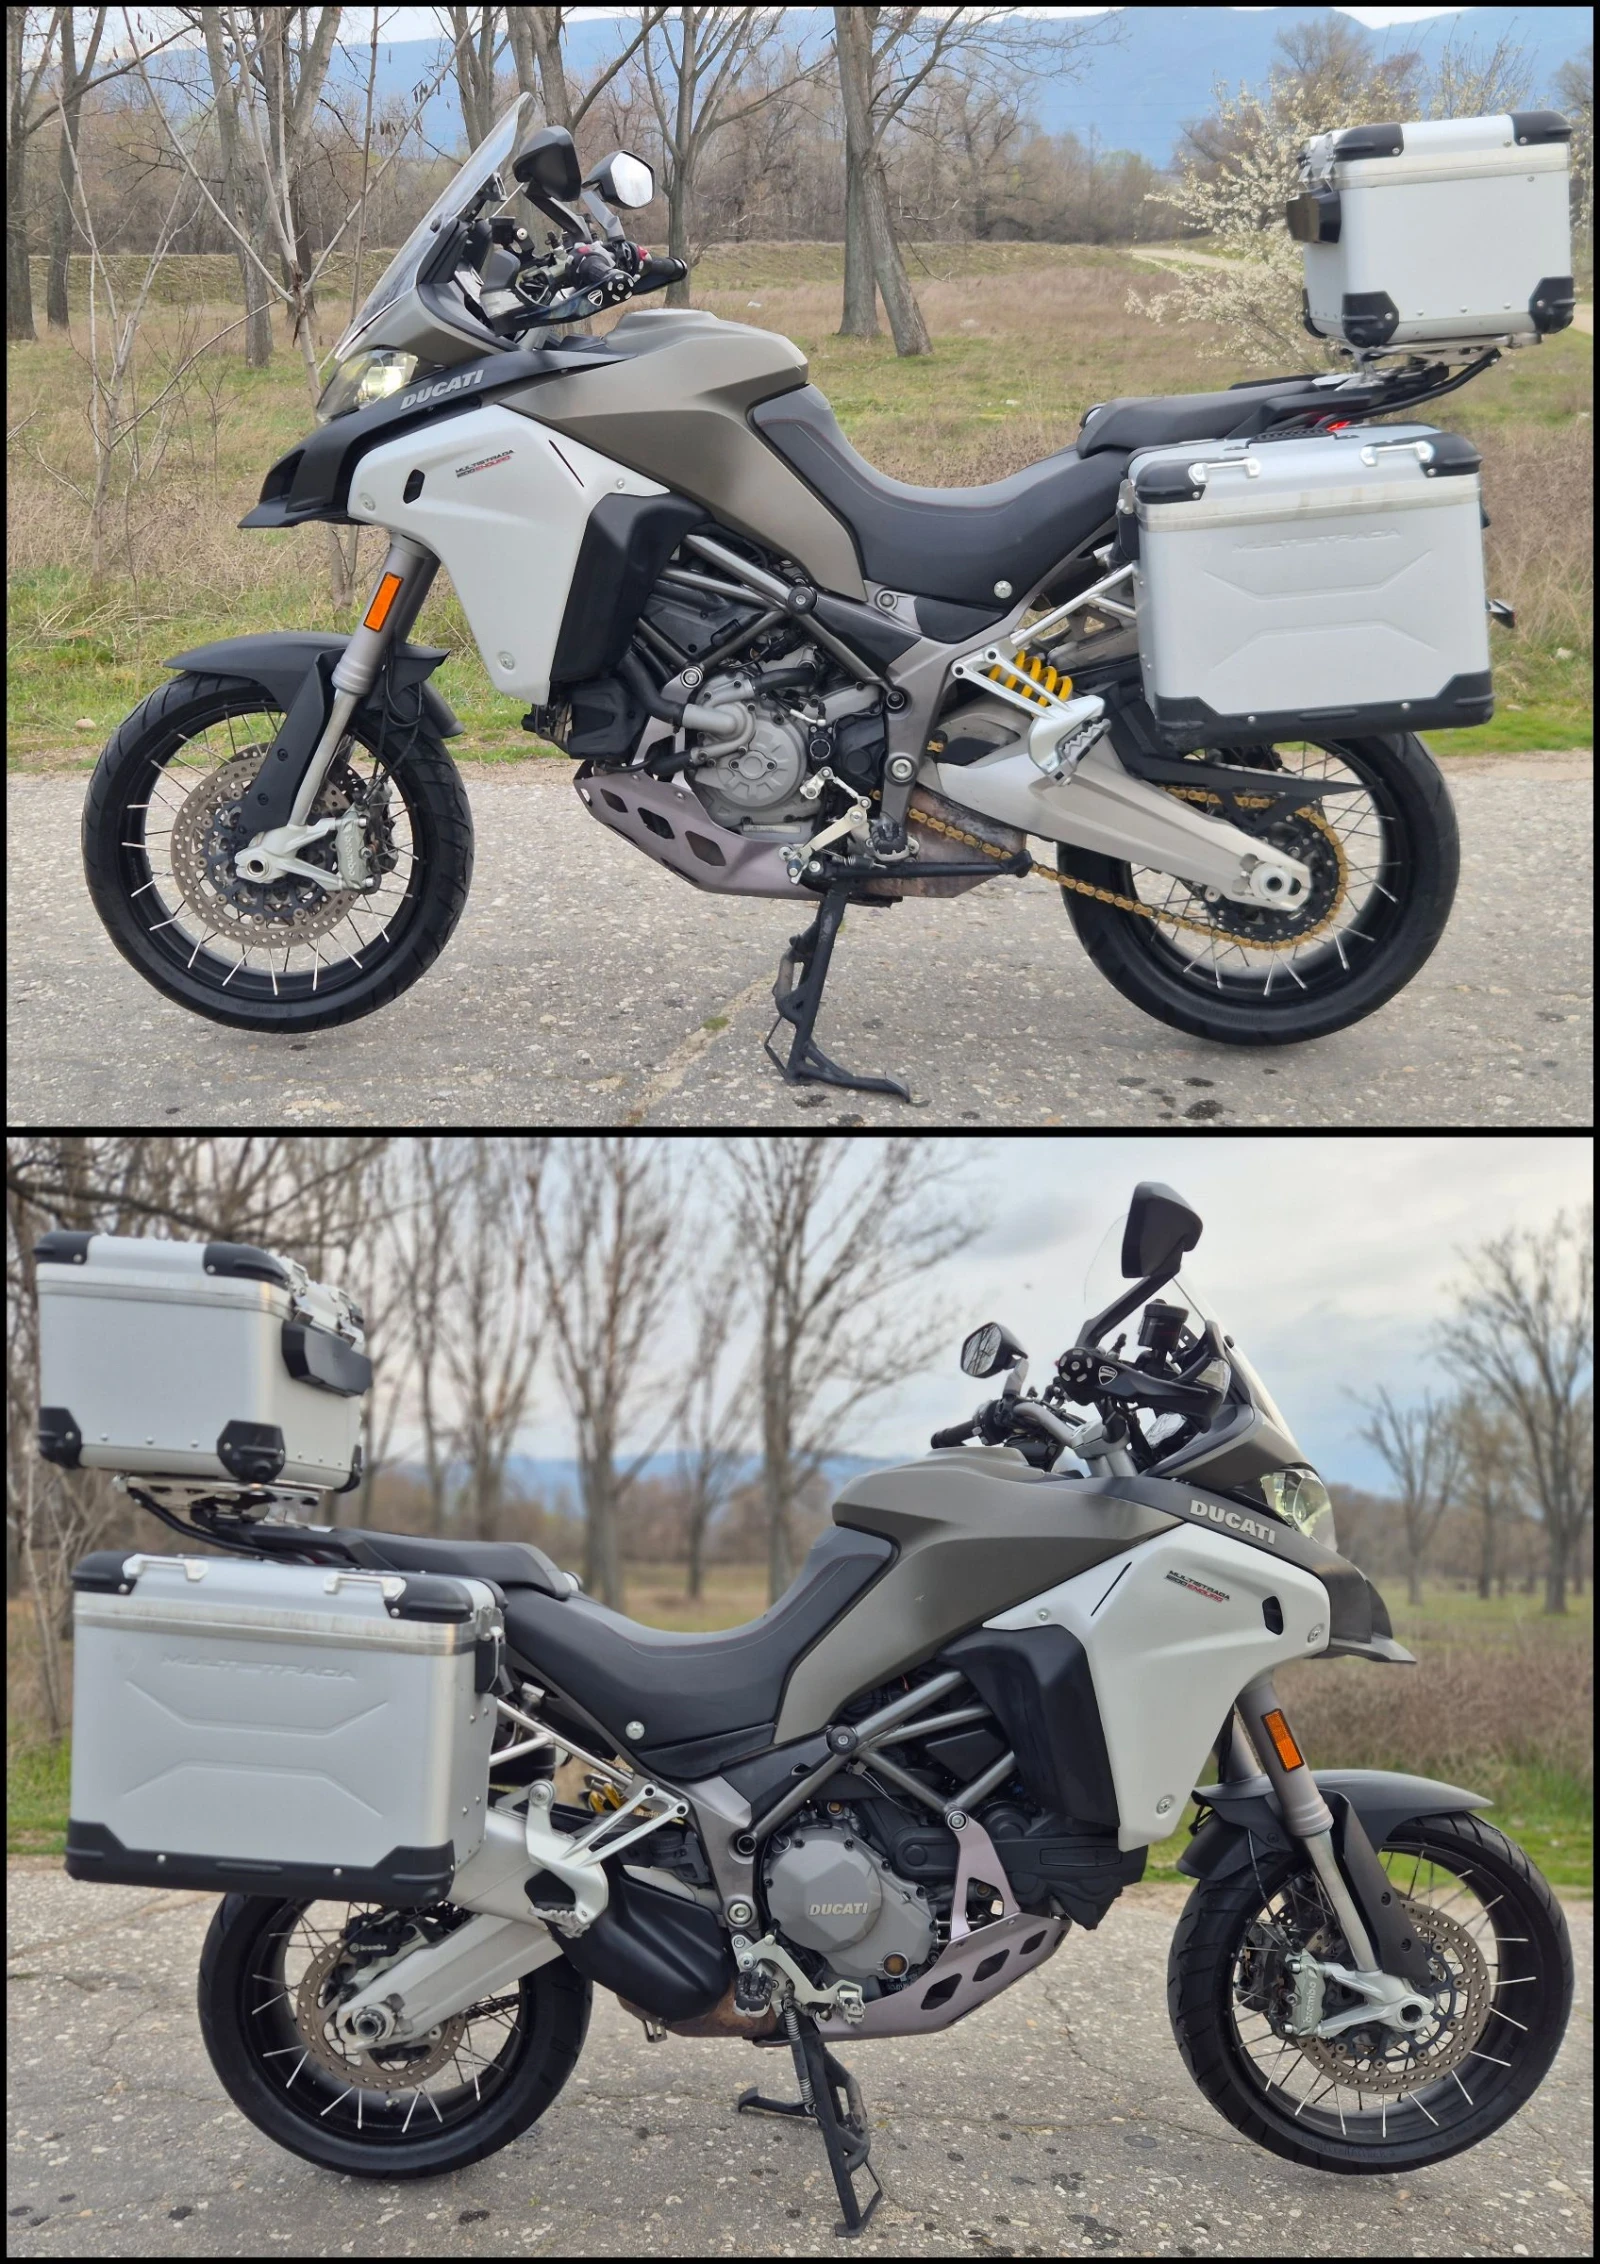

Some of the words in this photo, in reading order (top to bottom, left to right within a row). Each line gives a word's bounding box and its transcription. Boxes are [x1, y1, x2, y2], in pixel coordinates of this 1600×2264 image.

[400, 369, 485, 410] DUCATI
[1190, 1499, 1276, 1545] DUCATI
[1169, 1570, 1230, 1600] MULTISTRADA
[809, 1902, 868, 1916] DUCATI
[1303, 1981, 1317, 2023] brembo
